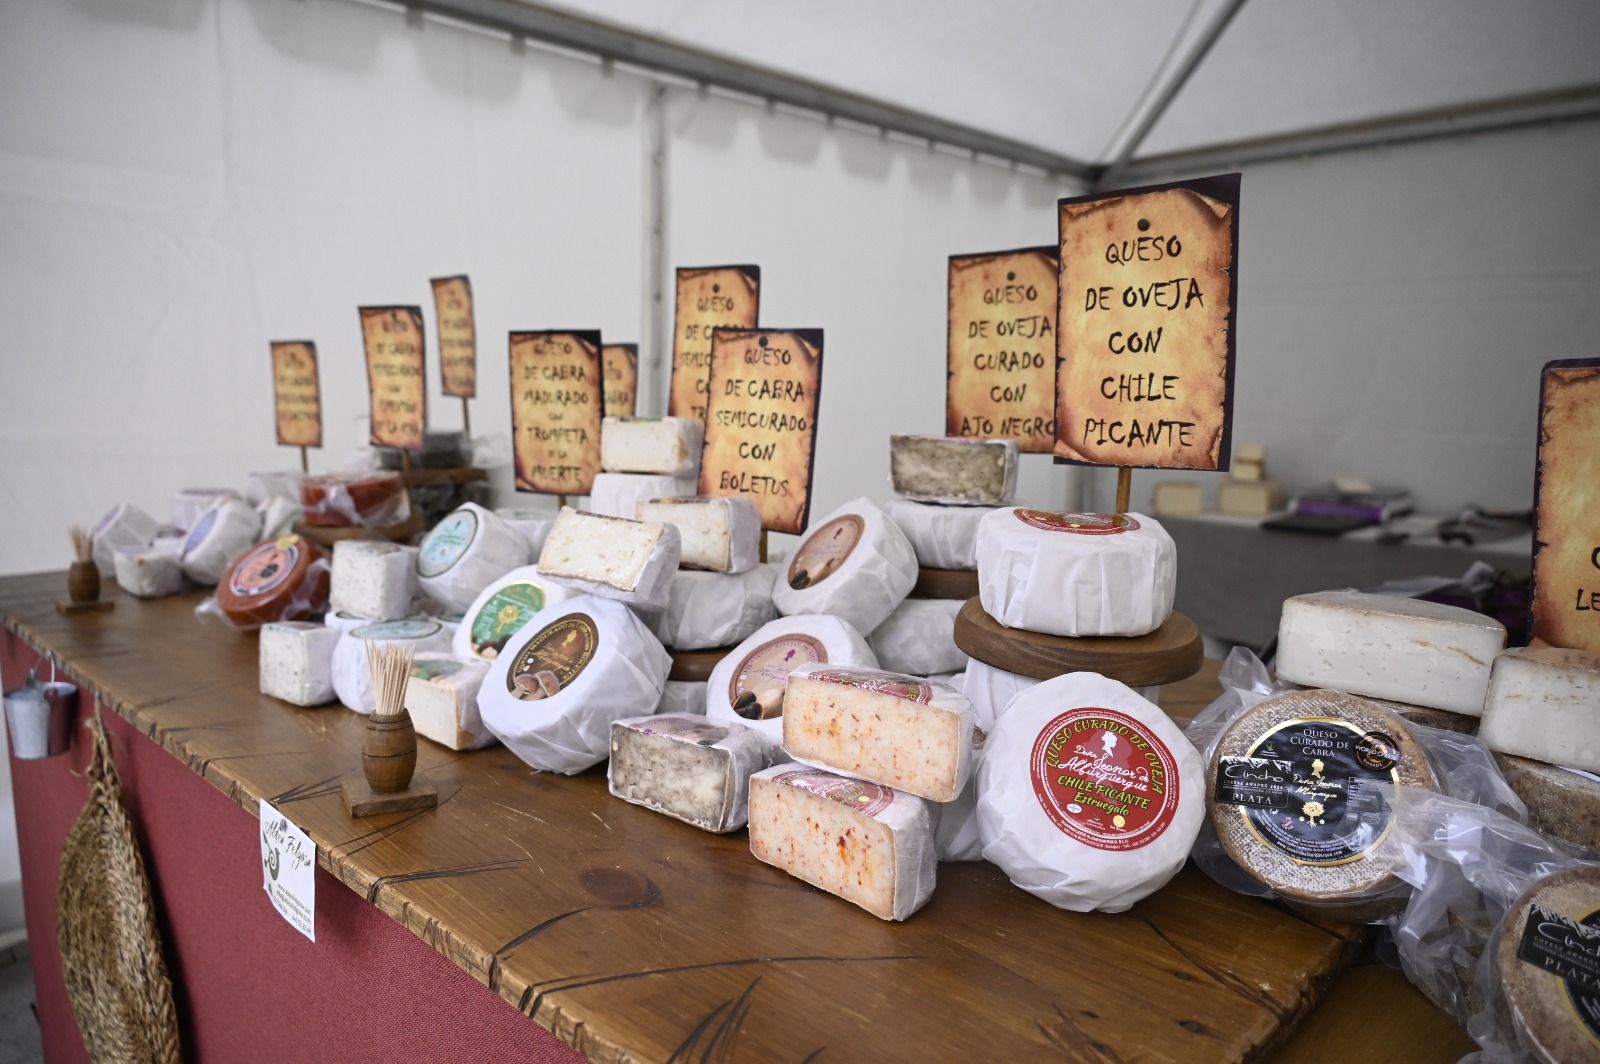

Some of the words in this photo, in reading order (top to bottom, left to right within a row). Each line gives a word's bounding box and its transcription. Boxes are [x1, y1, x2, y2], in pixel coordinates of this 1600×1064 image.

[1105, 235, 1181, 266] QUESO
[697, 296, 734, 312] QUESO
[983, 285, 1038, 305] QUESO
[1085, 287, 1114, 312] DE
[1122, 277, 1204, 311] OVEJA
[686, 324, 699, 340] DE
[968, 320, 990, 338] DE
[996, 315, 1054, 339] OVEJA
[1108, 327, 1163, 355] CON
[744, 347, 792, 366] QUESO
[974, 351, 1045, 372] CURADO
[542, 364, 587, 382] CABRA
[524, 389, 589, 406] MADURADO
[725, 379, 744, 396] DE
[747, 379, 805, 402] CABRA
[990, 383, 1027, 403] CON
[1100, 373, 1179, 402] CHILE
[716, 409, 807, 432] SEMICURADO
[961, 416, 994, 437] AJO
[1000, 416, 1055, 438] NEGRO
[526, 427, 588, 445] TROMPETA
[1083, 418, 1196, 448] PICANTE
[738, 442, 776, 460] CON
[532, 465, 583, 486] MUERTE
[719, 471, 790, 498] BOLETUS
[1290, 736, 1334, 748] CURADO
[1336, 741, 1350, 750] DE
[1303, 728, 1338, 740] QUESO
[1045, 727, 1073, 768] QUESO
[1074, 719, 1129, 737] CURADO
[1130, 733, 1147, 751] DE
[1144, 751, 1165, 795] OVEJA
[1302, 746, 1335, 758] CABRA
[1355, 744, 1377, 755] WORLD
[1093, 753, 1137, 778] Leonor
[1224, 764, 1284, 783] Cincho
[1057, 775, 1094, 792] CHILE
[1096, 784, 1151, 810] PICANTE
[1232, 793, 1272, 805] PLATA
[1073, 791, 1130, 816] Estruegalo
